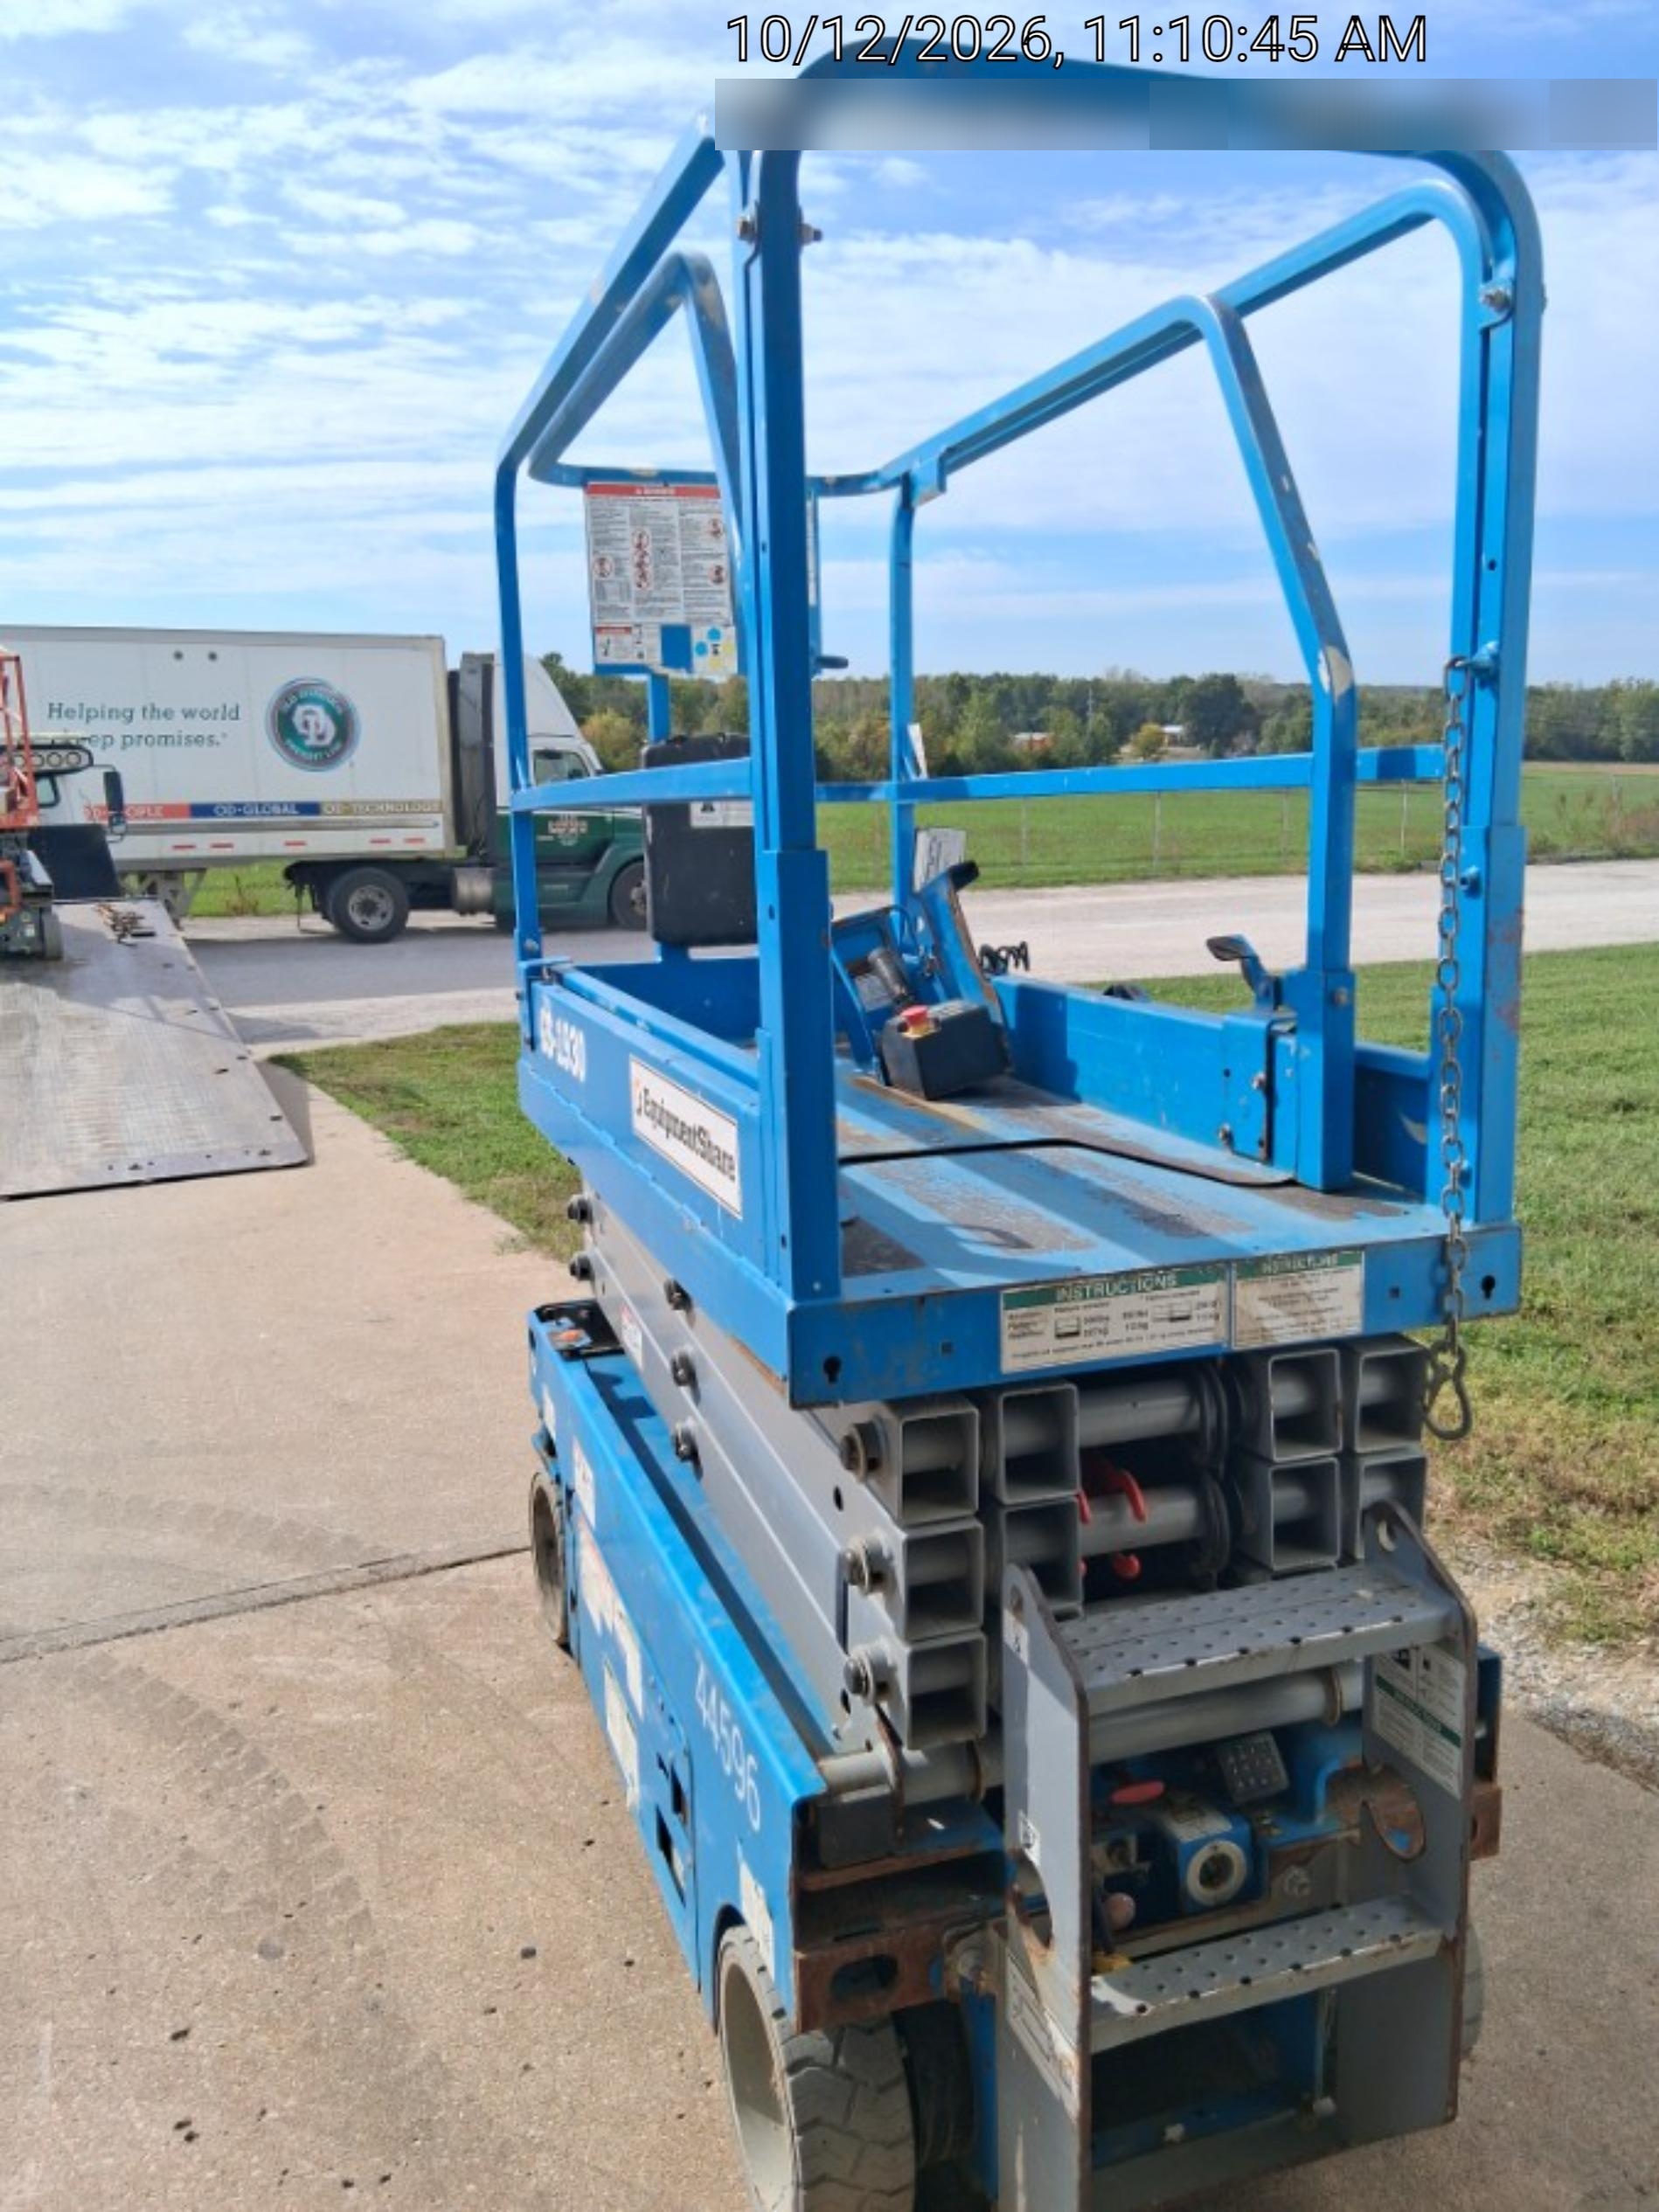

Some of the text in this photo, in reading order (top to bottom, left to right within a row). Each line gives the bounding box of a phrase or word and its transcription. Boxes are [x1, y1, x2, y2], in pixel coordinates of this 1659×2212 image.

[47, 702, 241, 725] Helping the world
[696, 1657, 761, 1832] 44596
